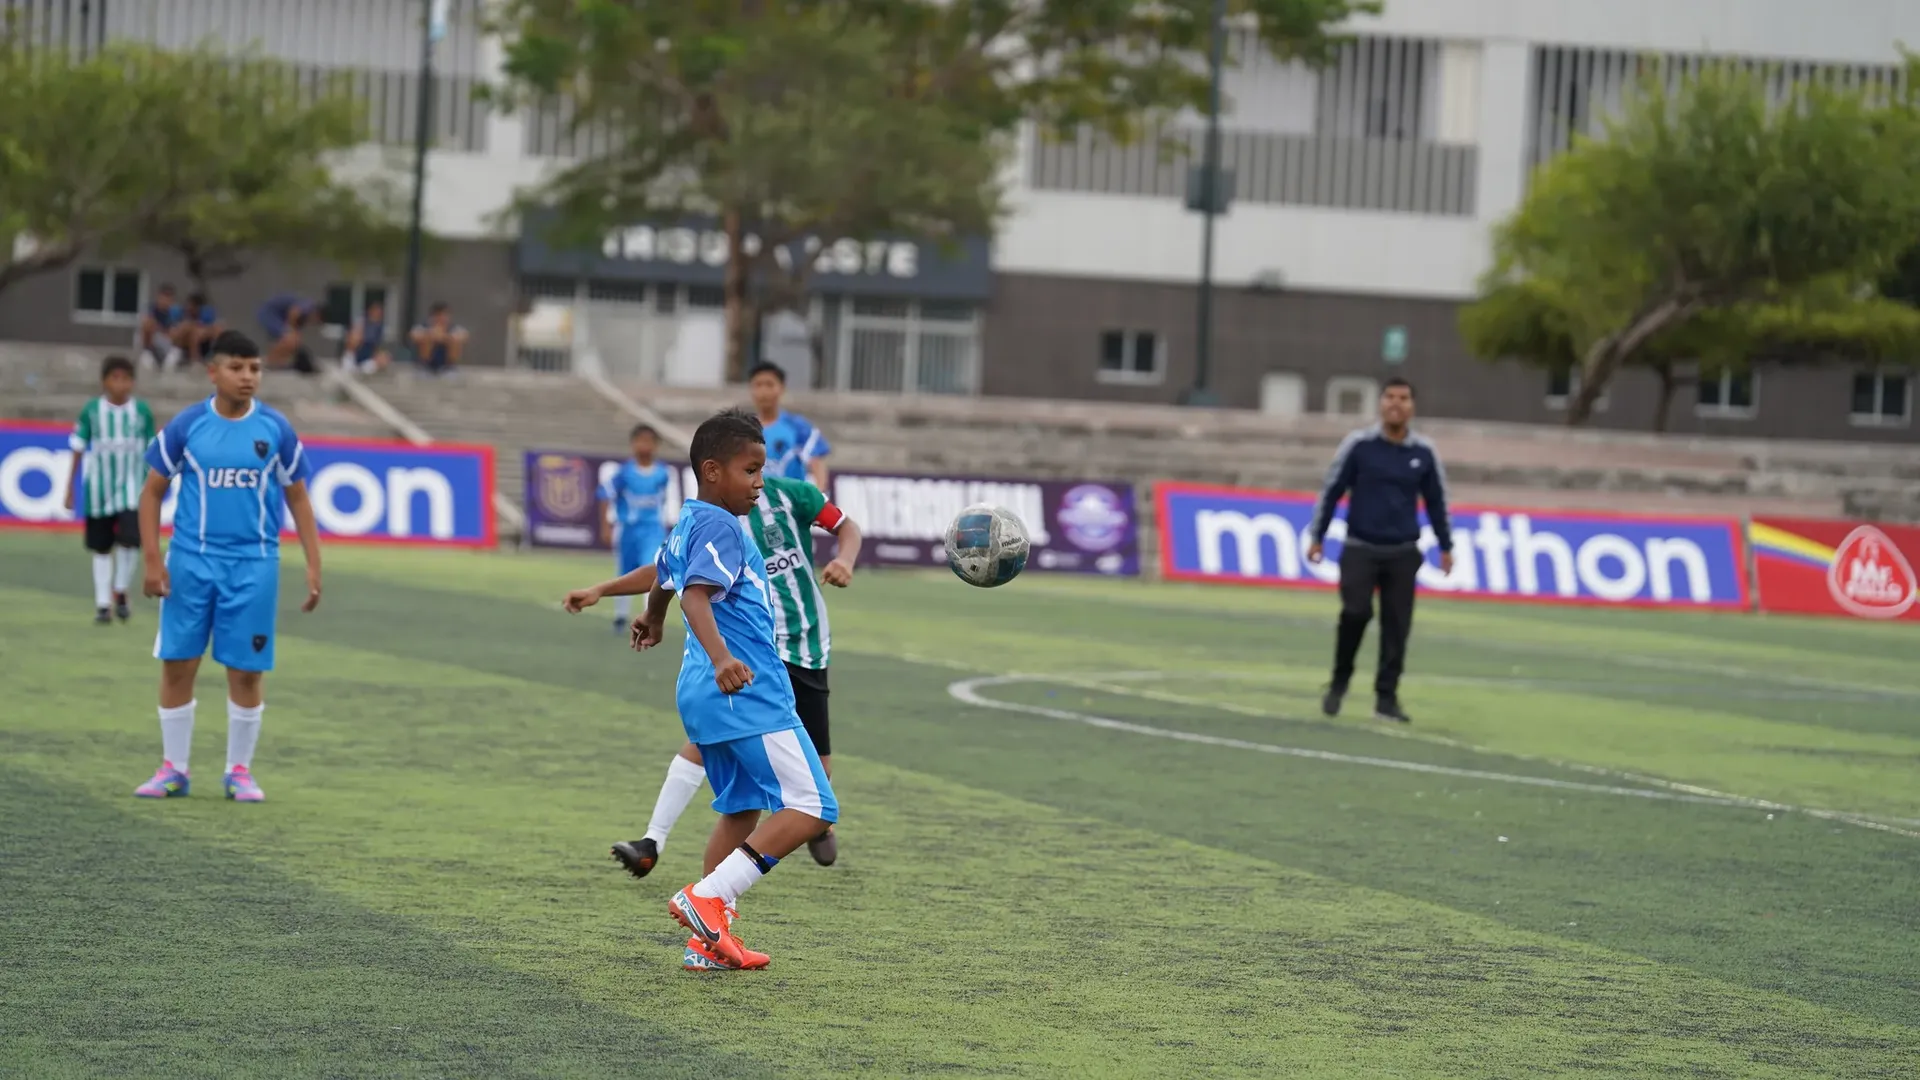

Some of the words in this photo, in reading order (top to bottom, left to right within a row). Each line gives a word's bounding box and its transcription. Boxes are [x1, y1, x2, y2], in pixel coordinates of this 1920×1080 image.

[208, 467, 260, 488] UECS
[766, 551, 800, 575] son
[1195, 508, 1712, 604] mathon
